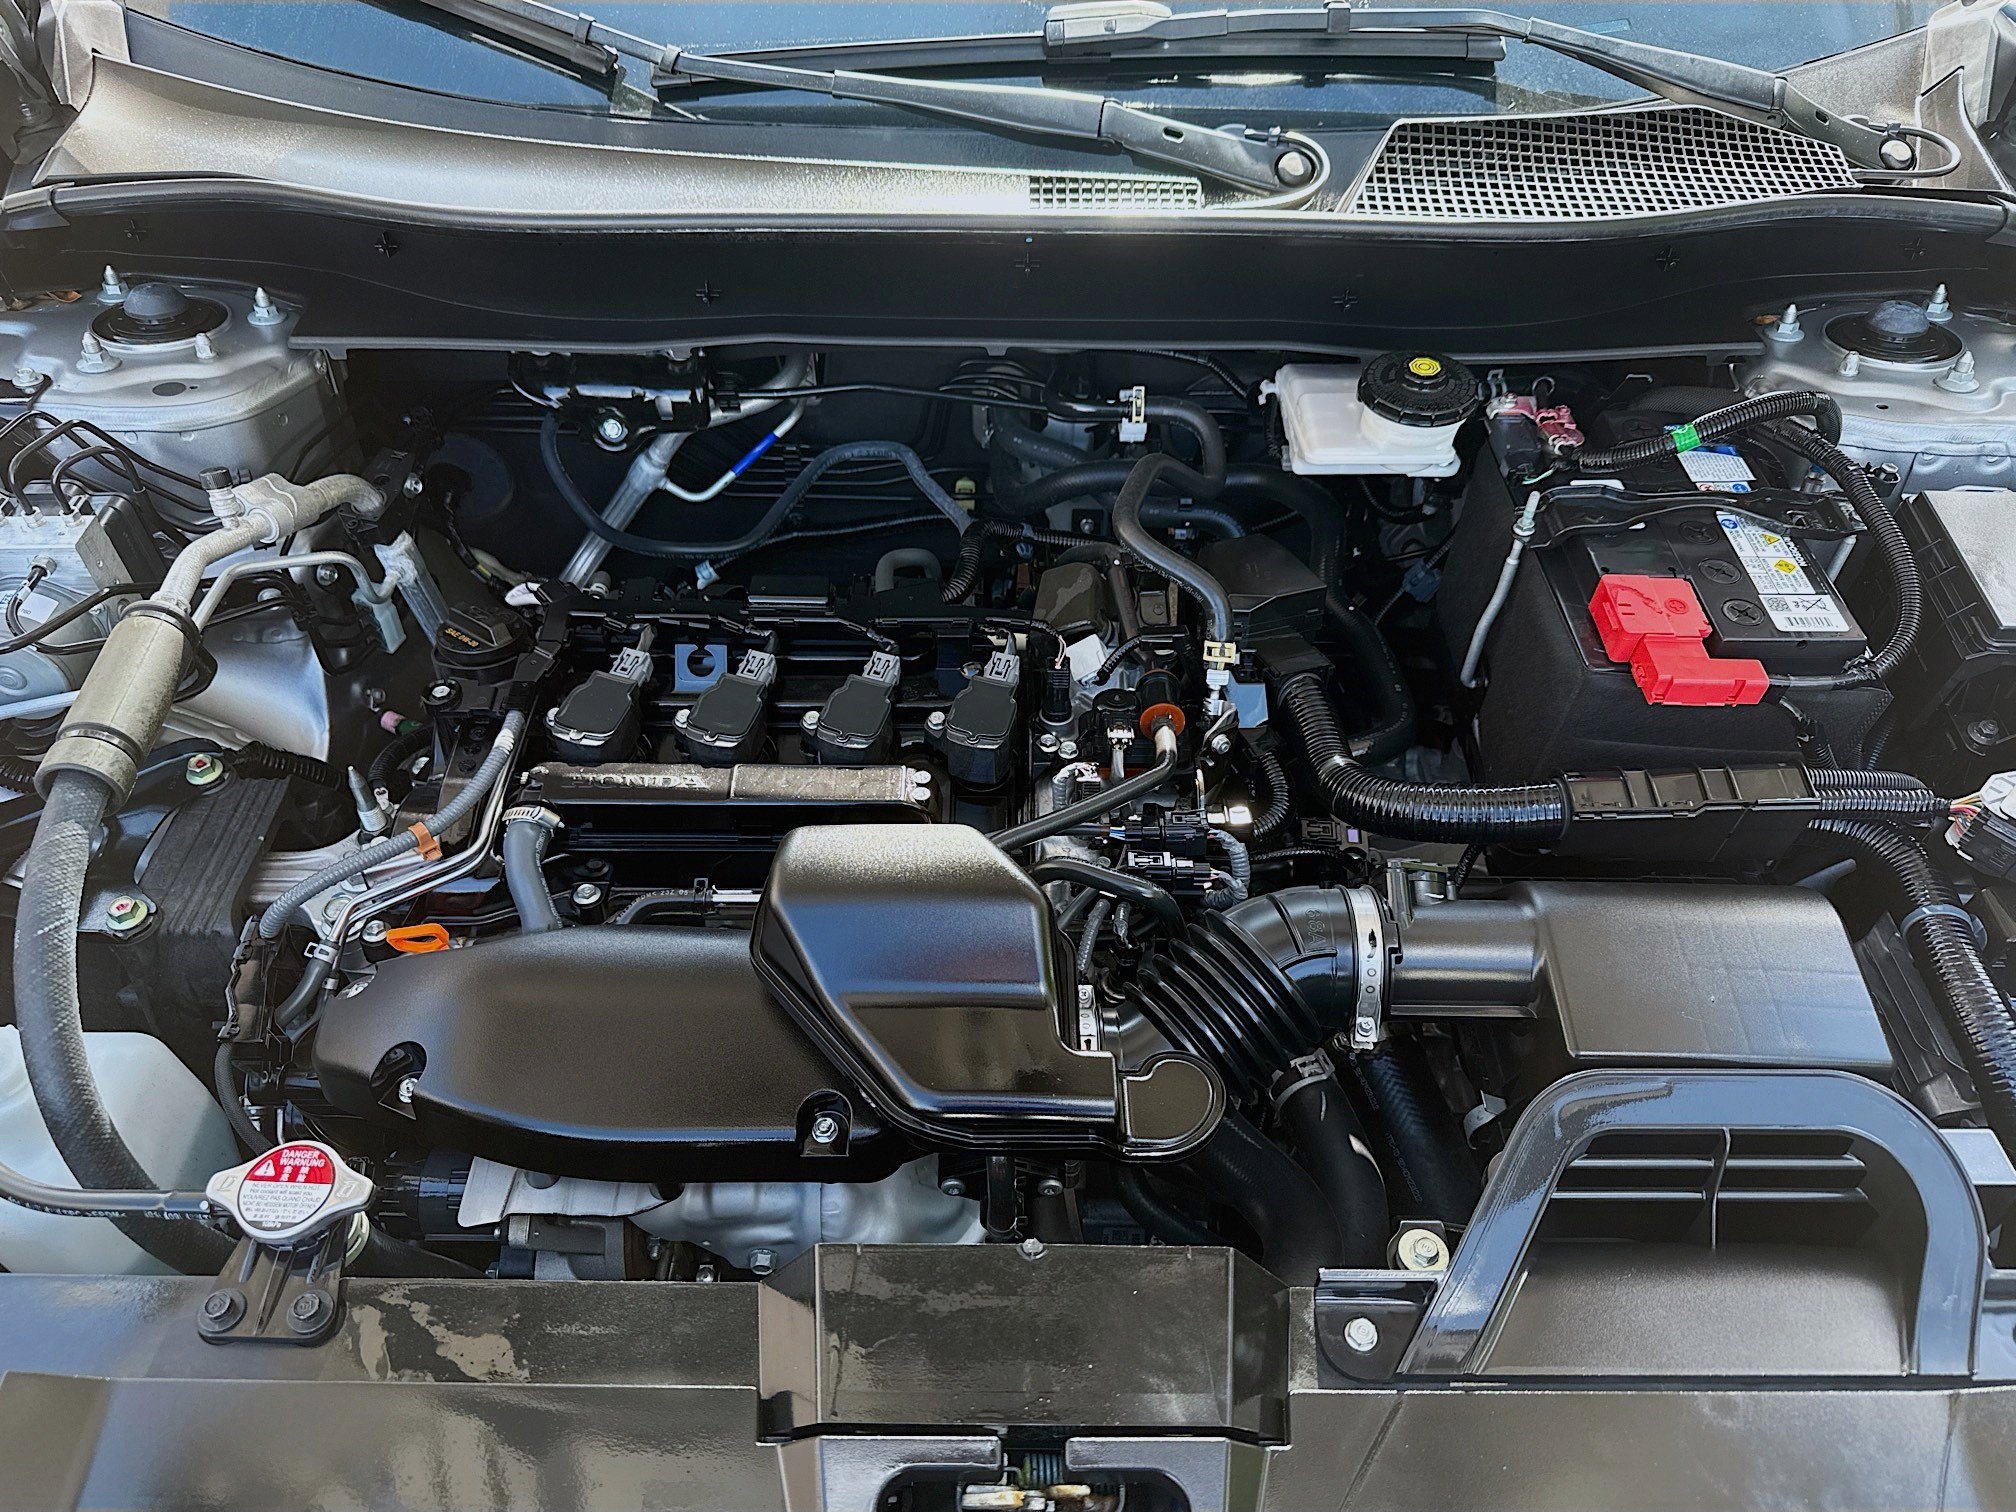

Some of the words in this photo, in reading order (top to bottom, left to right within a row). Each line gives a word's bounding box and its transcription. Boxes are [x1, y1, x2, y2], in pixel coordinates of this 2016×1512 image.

[445, 627, 462, 638] SAE
[561, 773, 711, 789] HONDA
[282, 1150, 320, 1159] DANGER
[280, 1157, 326, 1168] WARNUNG
